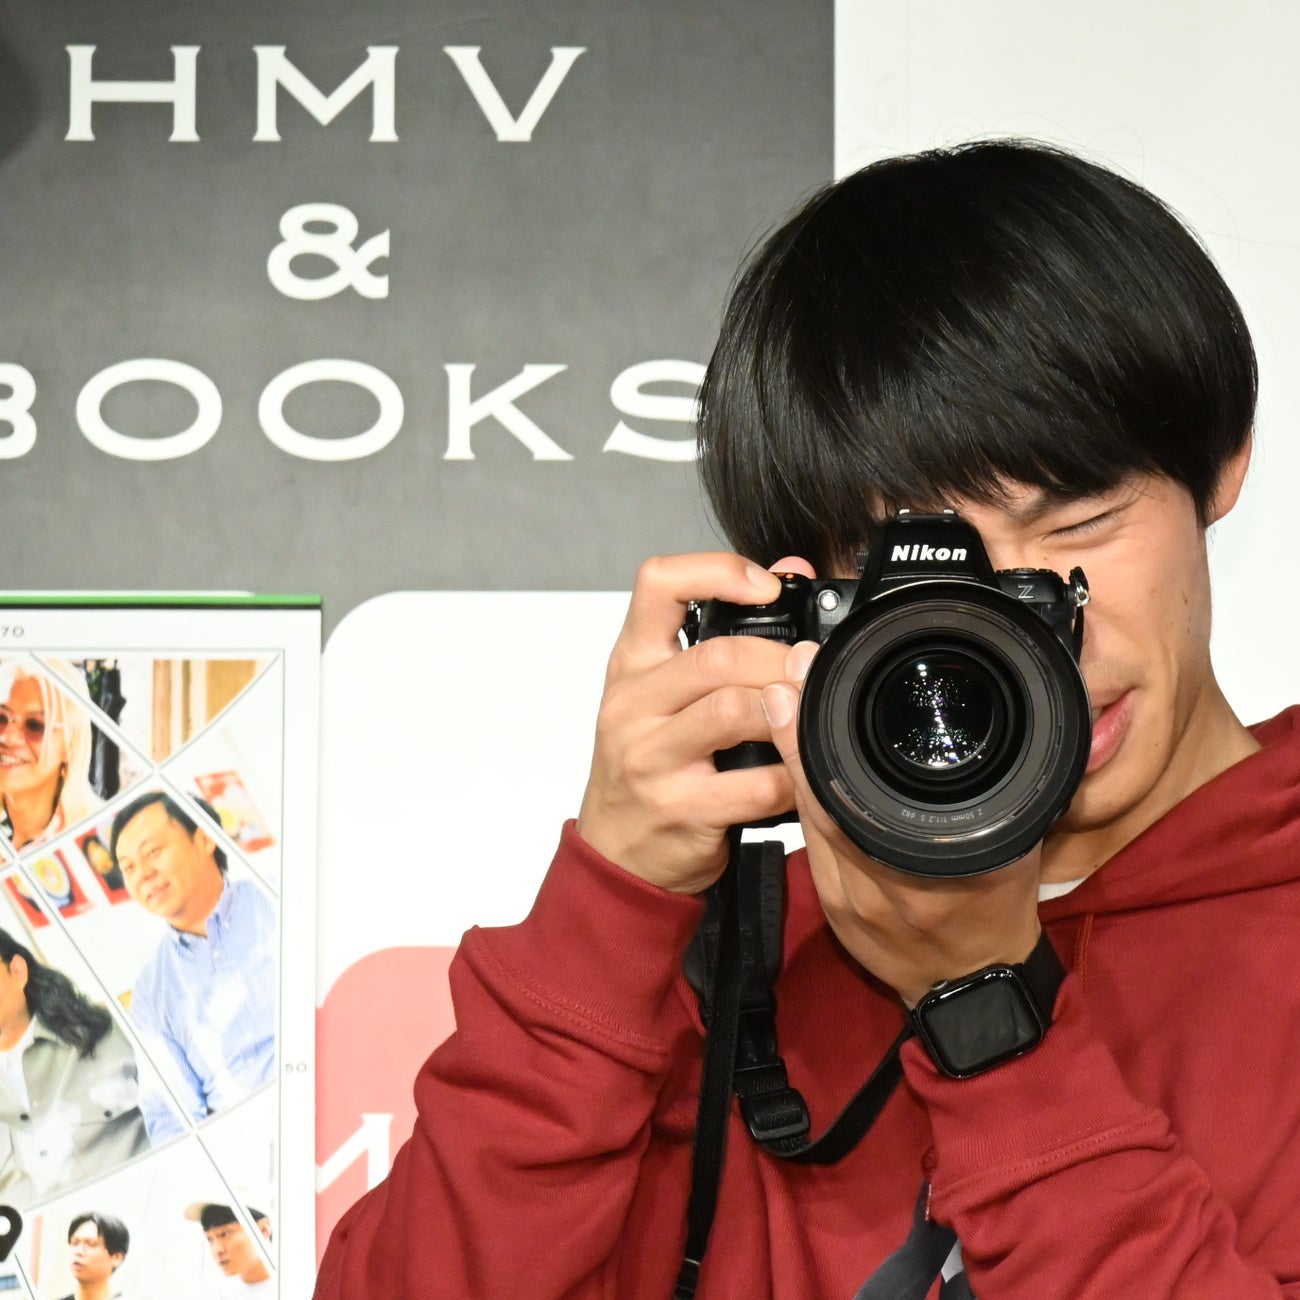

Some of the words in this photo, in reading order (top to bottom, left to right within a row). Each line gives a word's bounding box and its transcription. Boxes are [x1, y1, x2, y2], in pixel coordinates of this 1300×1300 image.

[66, 46, 586, 142] HMV
[267, 203, 390, 300] &
[891, 544, 968, 562] Nikon
